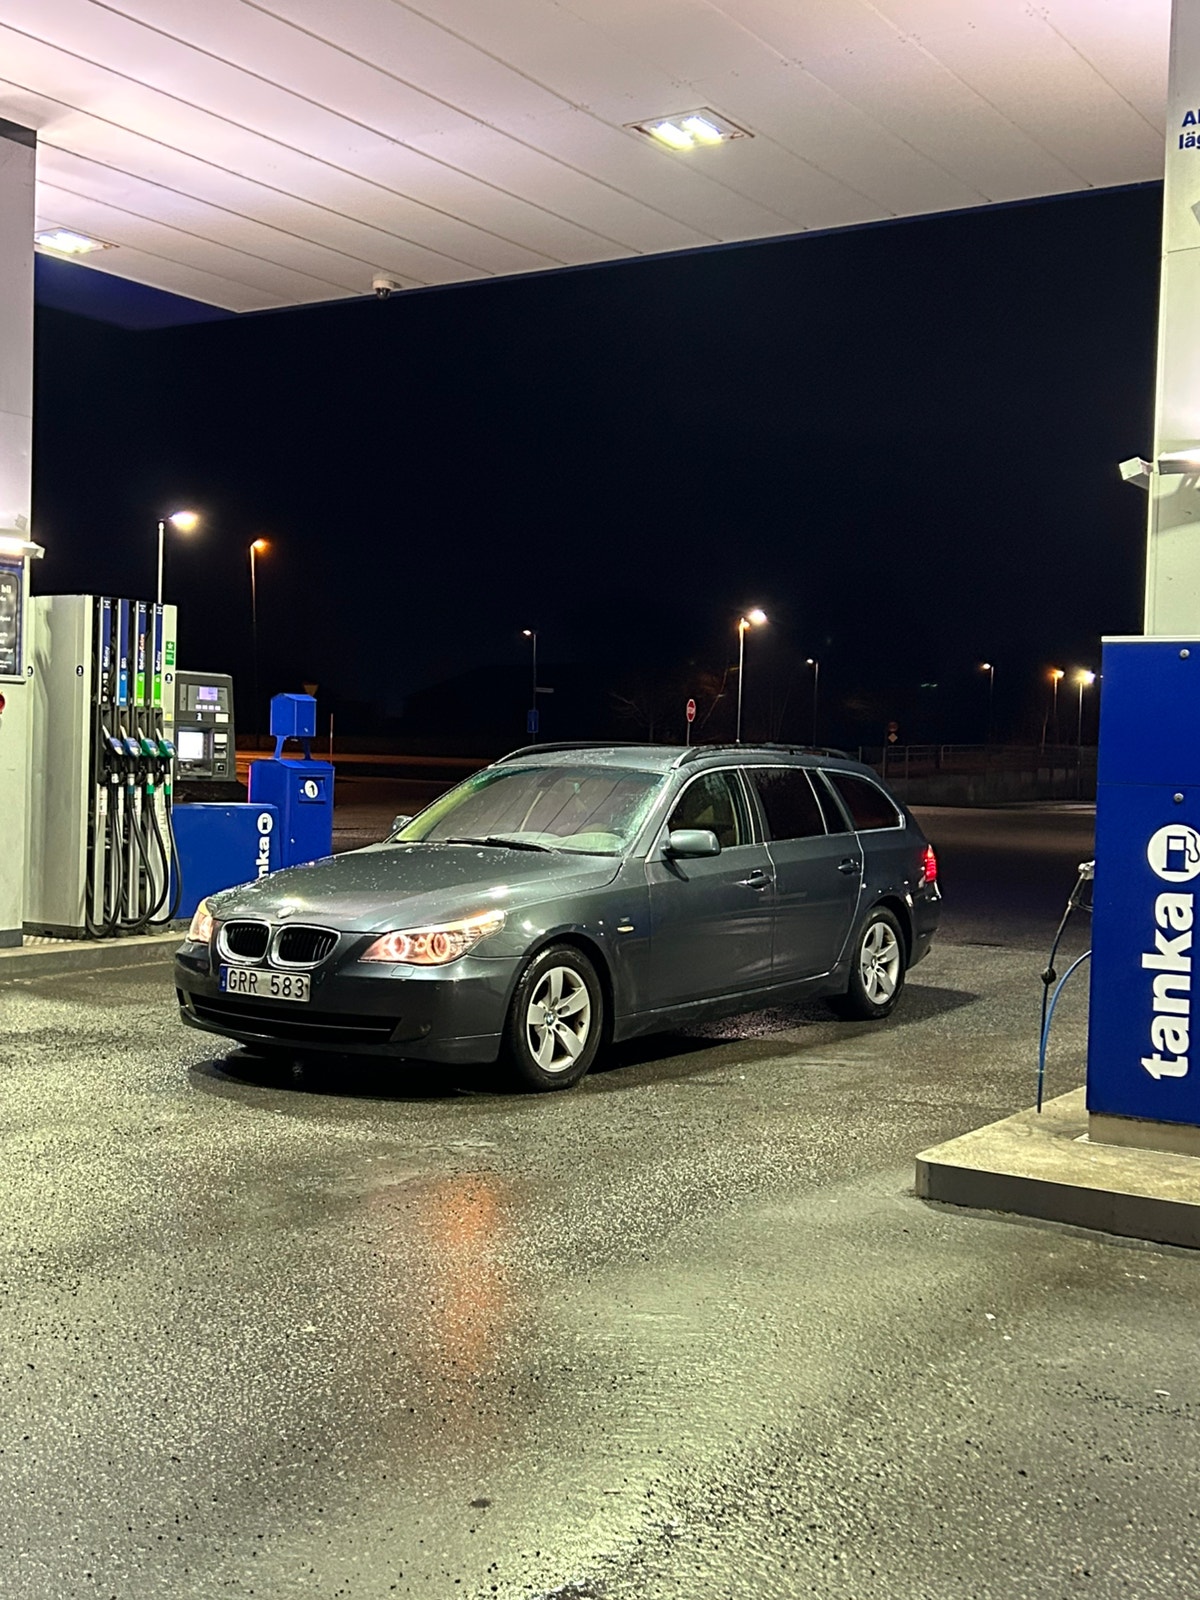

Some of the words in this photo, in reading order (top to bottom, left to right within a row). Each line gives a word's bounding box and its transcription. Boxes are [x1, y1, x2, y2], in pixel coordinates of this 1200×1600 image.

[229, 970, 257, 993] GRR
[270, 975, 304, 998] 583
[1141, 892, 1194, 1080] tanka
